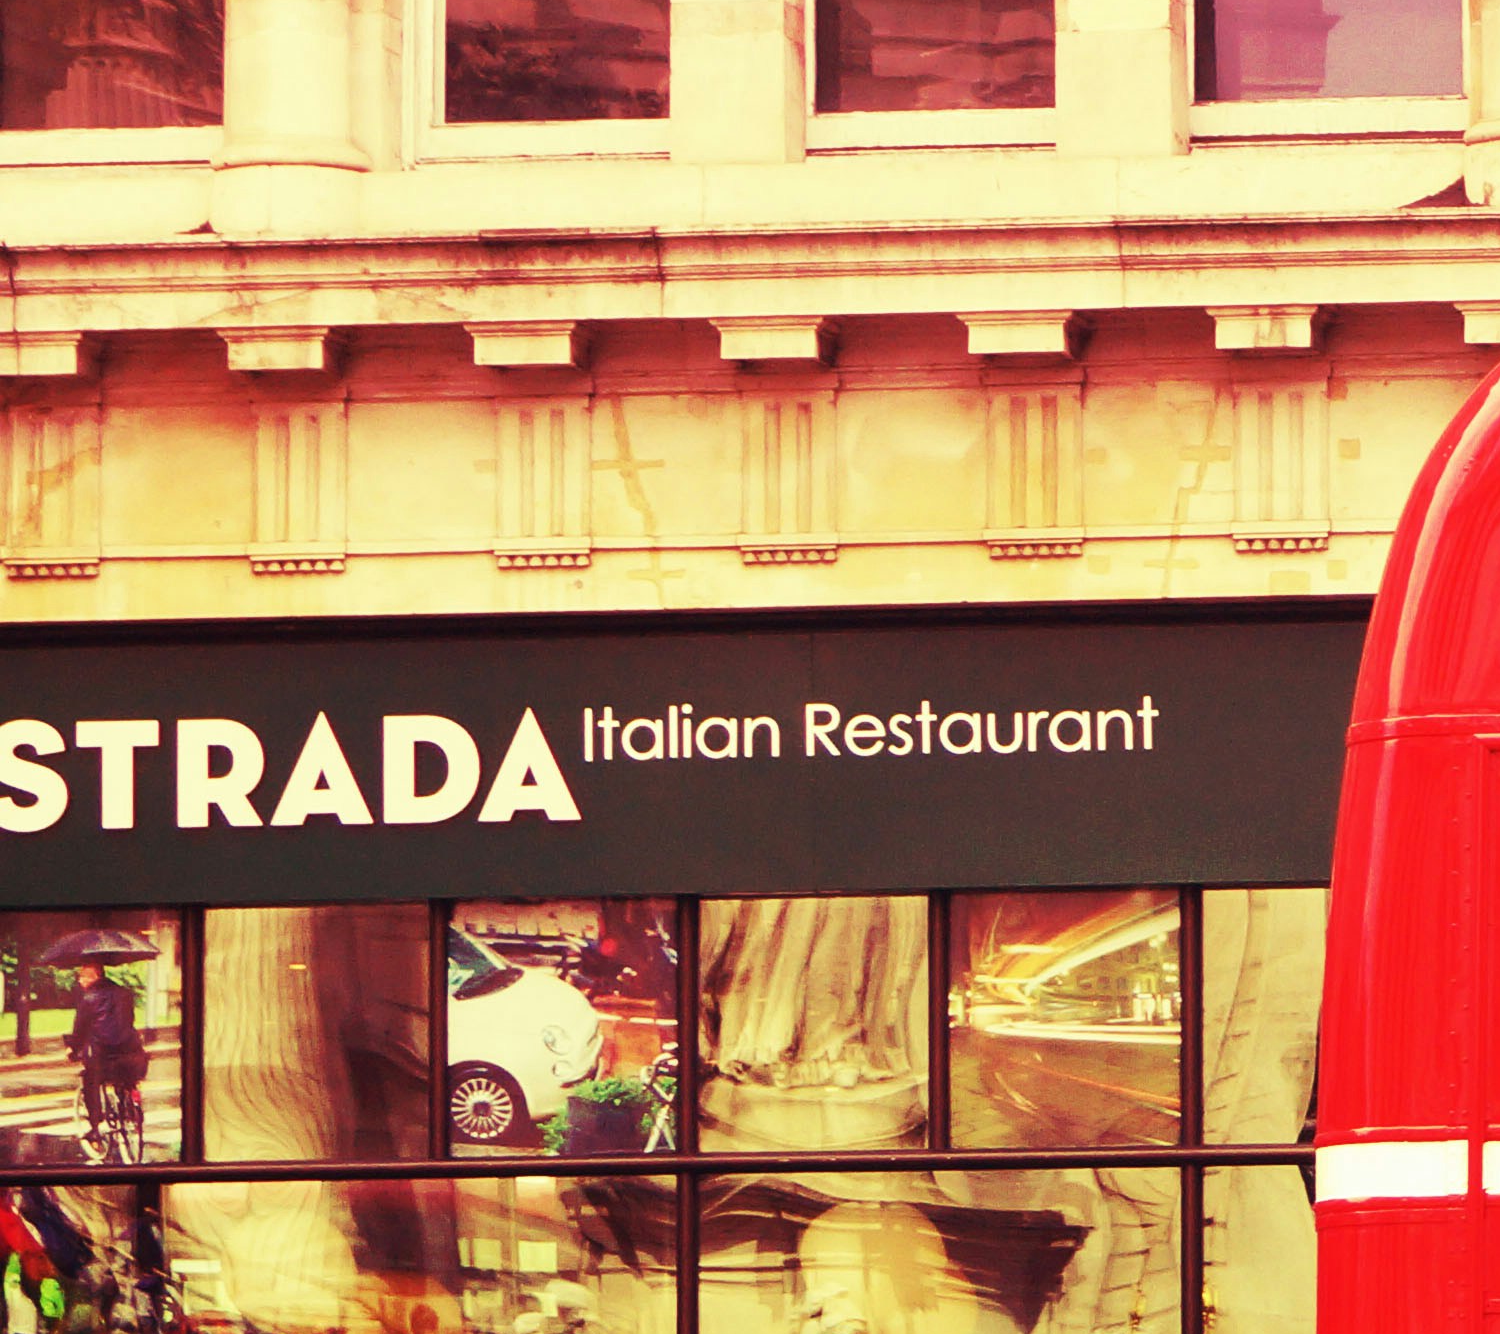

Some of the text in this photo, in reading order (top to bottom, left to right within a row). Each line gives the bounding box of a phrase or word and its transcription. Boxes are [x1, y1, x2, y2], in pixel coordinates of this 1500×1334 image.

[0, 695, 1160, 834] STRADA Italian Restaurant
